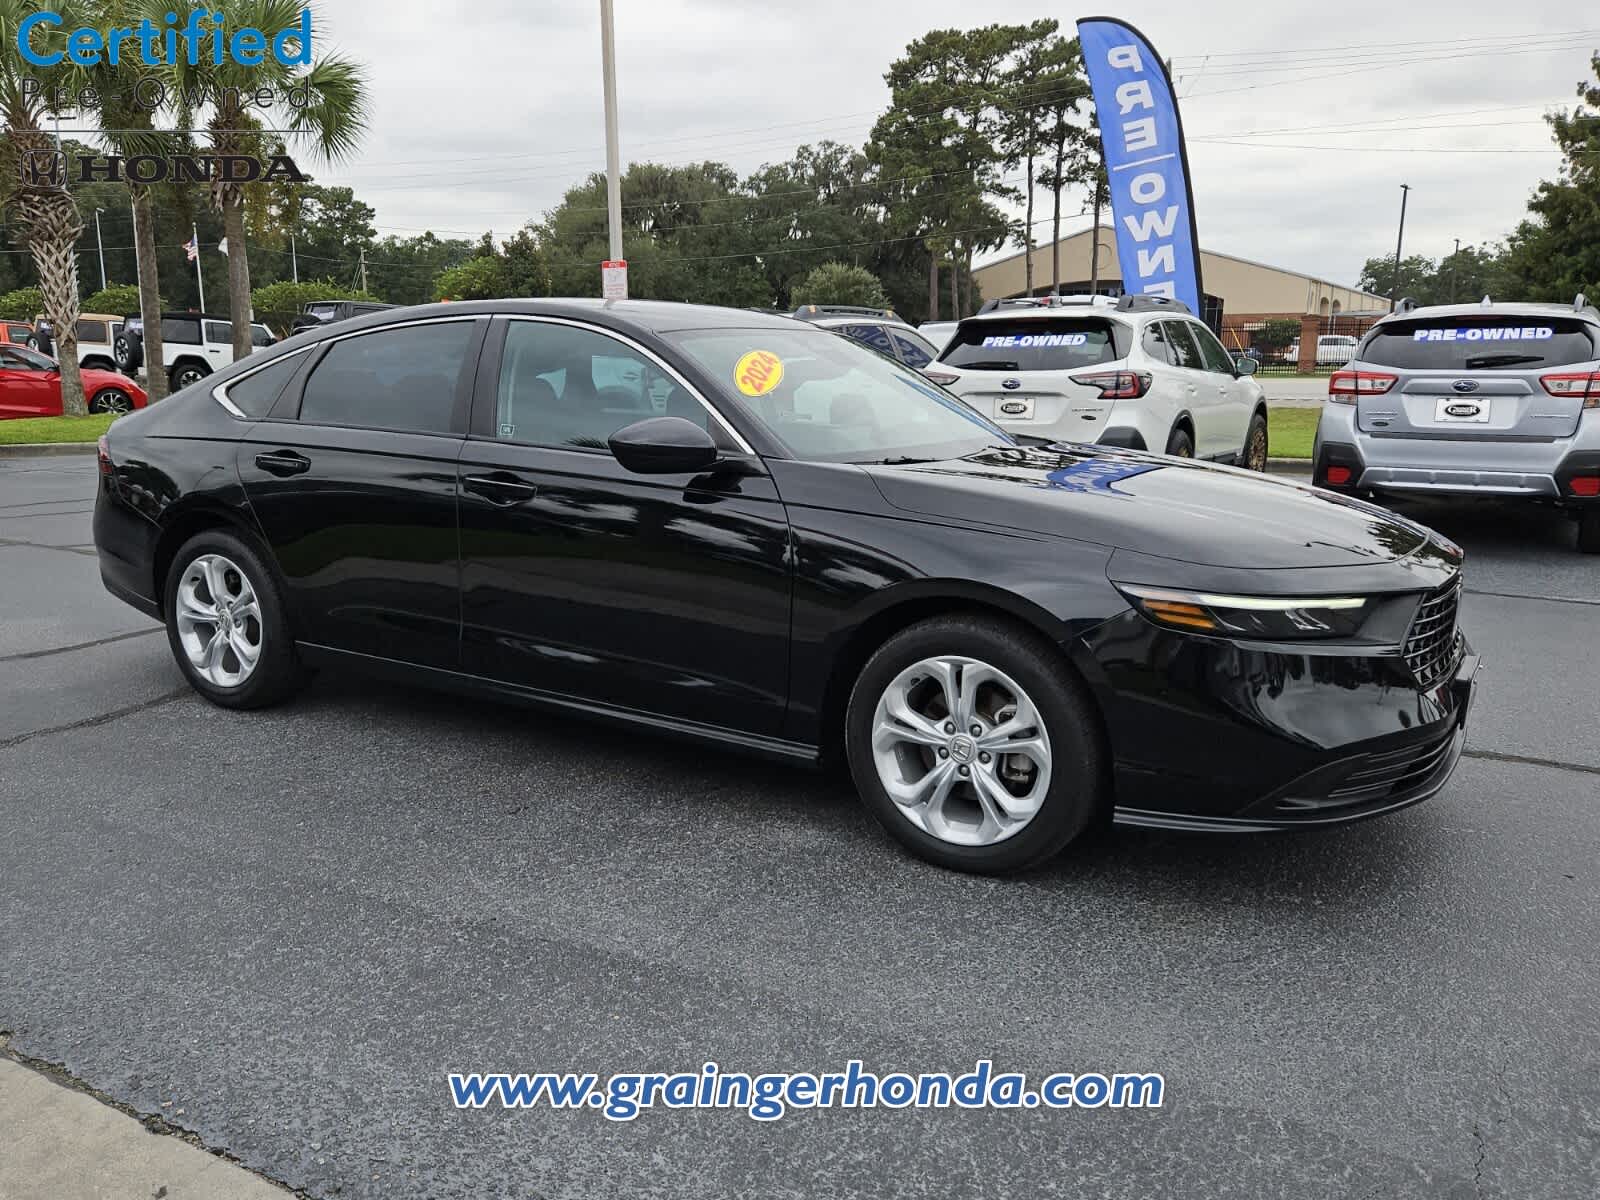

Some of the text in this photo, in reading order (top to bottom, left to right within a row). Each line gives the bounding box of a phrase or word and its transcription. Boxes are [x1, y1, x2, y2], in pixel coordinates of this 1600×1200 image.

[981, 334, 1087, 347] PRE-OWNED
[1414, 327, 1553, 341] PRE-OWNED
[740, 352, 778, 393] 2024
